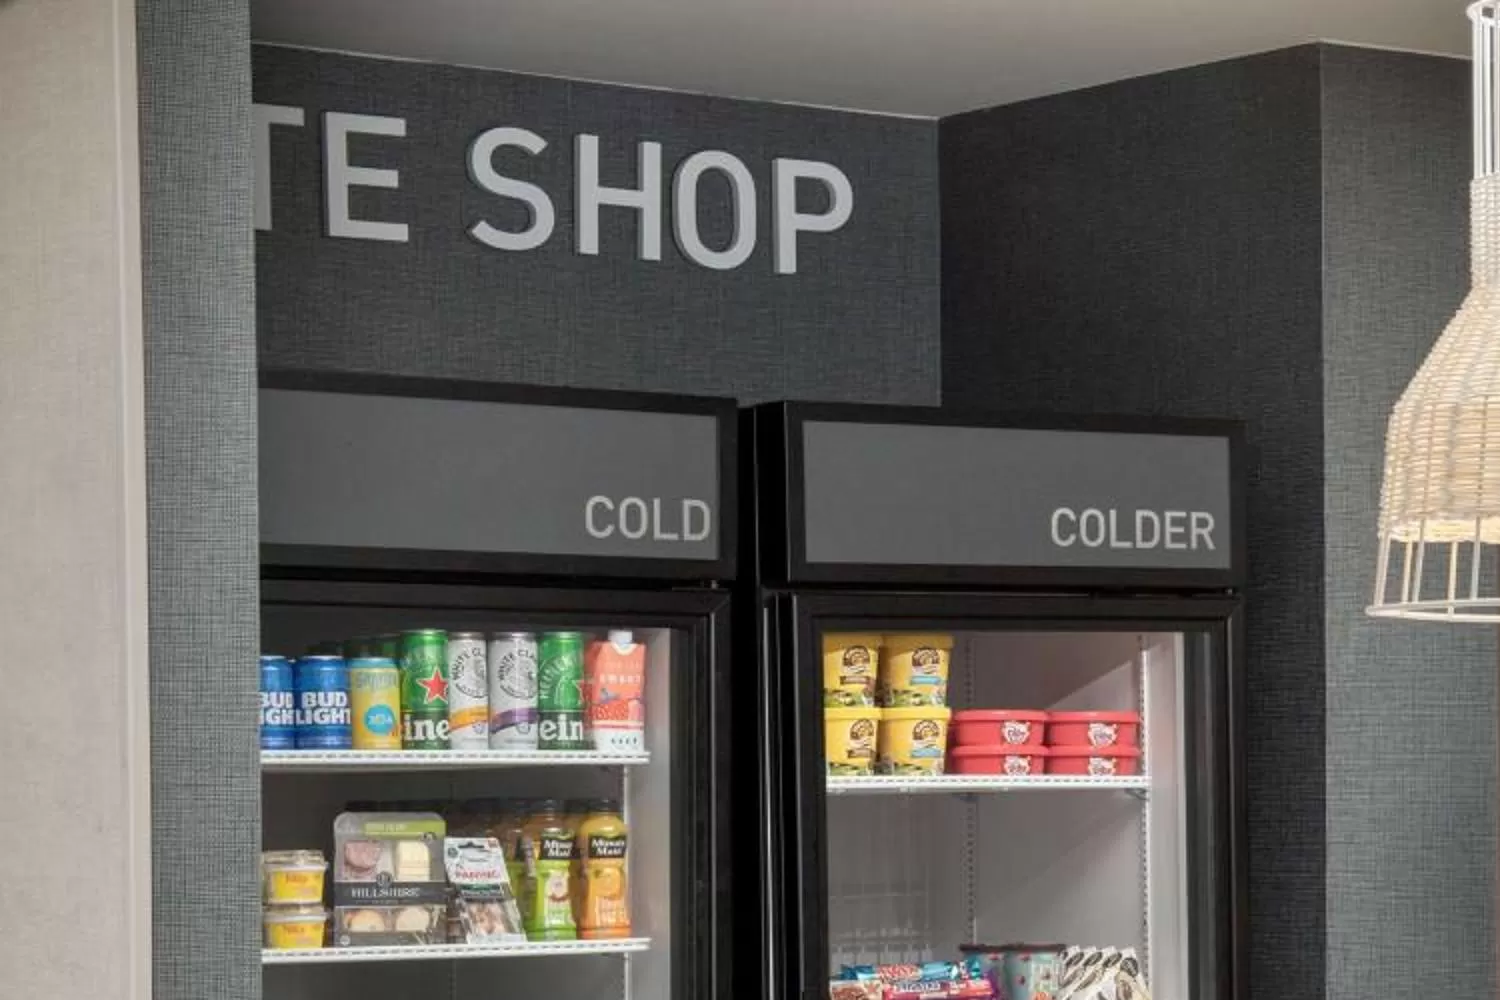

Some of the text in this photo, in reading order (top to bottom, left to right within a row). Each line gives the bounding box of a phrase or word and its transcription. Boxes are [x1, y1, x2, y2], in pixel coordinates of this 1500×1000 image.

[466, 126, 854, 275] SHOP
[584, 495, 712, 542] COLD
[1050, 507, 1216, 550] COLDER
[295, 707, 352, 725] LIGHT
[301, 691, 348, 709] BUD
